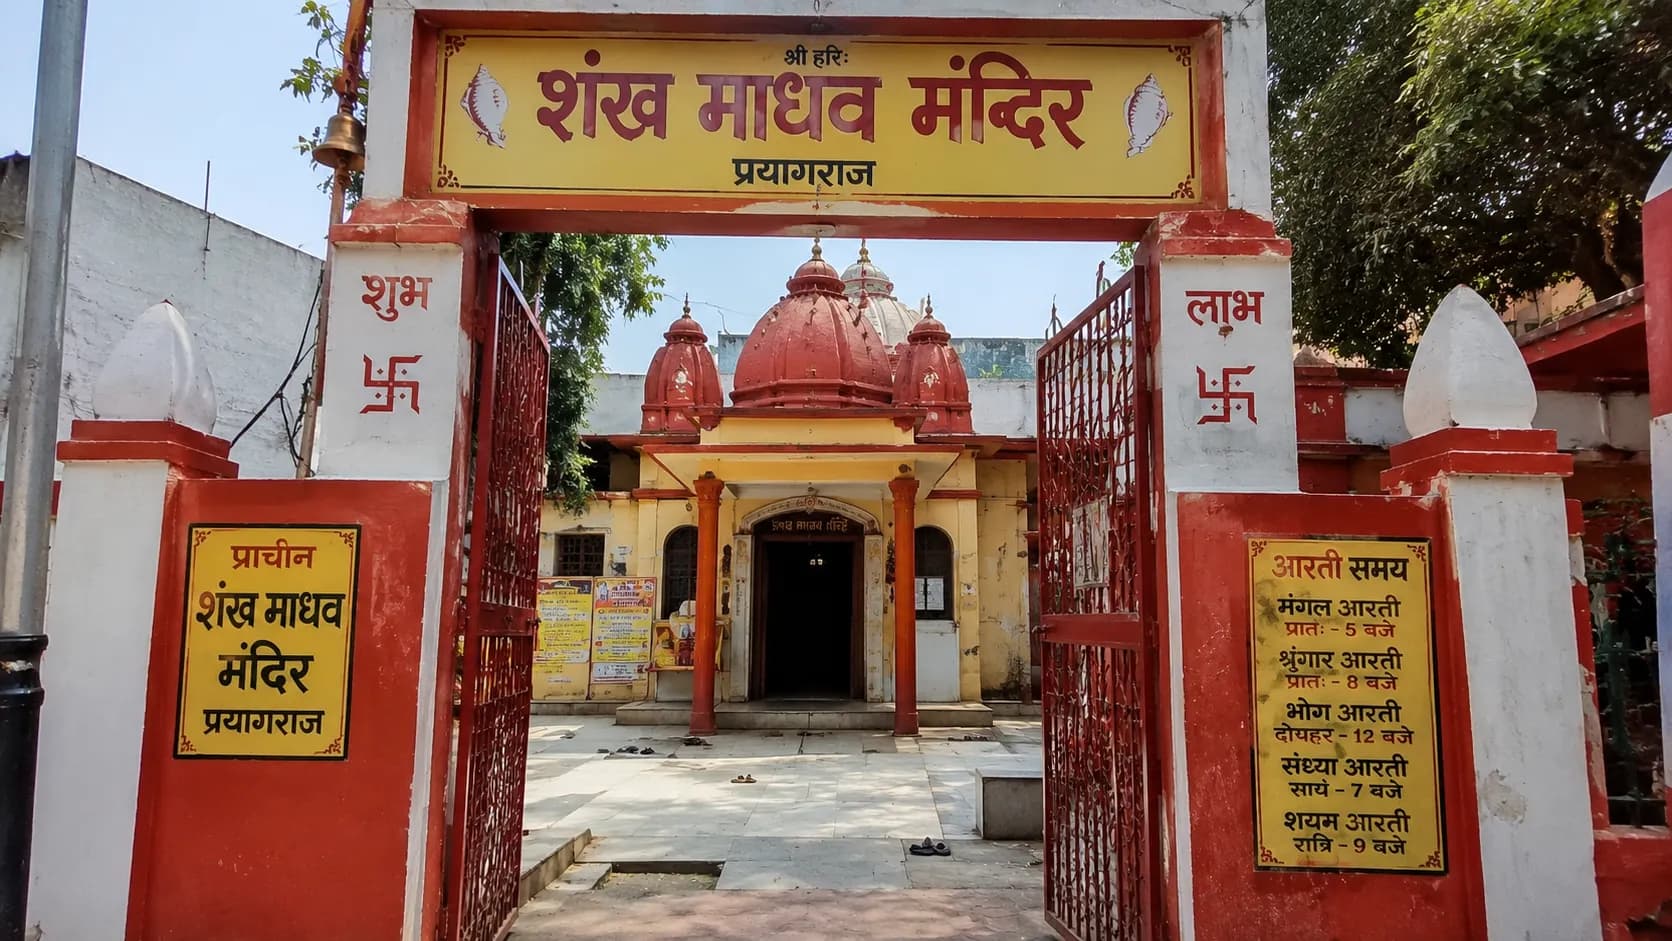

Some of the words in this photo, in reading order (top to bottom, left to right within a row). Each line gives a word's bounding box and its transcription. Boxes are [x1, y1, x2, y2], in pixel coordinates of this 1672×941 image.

[784, 44, 808, 65] श्री
[537, 49, 675, 142] शंख
[696, 72, 883, 143] माधव
[732, 158, 876, 187] प्रयागराज
[361, 275, 432, 322] शुभ
[1185, 290, 1264, 326] लाभ
[230, 538, 316, 569] प्राचीन
[1272, 549, 1343, 580] आरती
[1349, 558, 1409, 581] समय
[196, 580, 259, 630] शंख
[265, 592, 345, 628] माधव
[1277, 594, 1332, 616] मंगल
[1338, 595, 1401, 617] आरती
[1345, 623, 1356, 636] 5
[1363, 620, 1396, 638] बजे
[218, 640, 314, 694] मंदिर
[1341, 647, 1402, 670] आरती
[1347, 675, 1358, 689] 8
[1364, 672, 1398, 690] बजे
[203, 709, 325, 735] प्रयागराज
[1287, 697, 1331, 721] भोग
[1338, 700, 1402, 722] आरती
[1353, 729, 1374, 743] 12
[1381, 726, 1414, 744] बजे
[1281, 752, 1338, 776] संध्या
[1344, 754, 1408, 777] आरती
[1289, 779, 1329, 797] सायं
[1351, 783, 1363, 797] 7
[1346, 809, 1411, 833] आरती
[1293, 833, 1333, 852] रात्रि
[1354, 838, 1365, 853] 9
[1372, 835, 1406, 854] बजे
